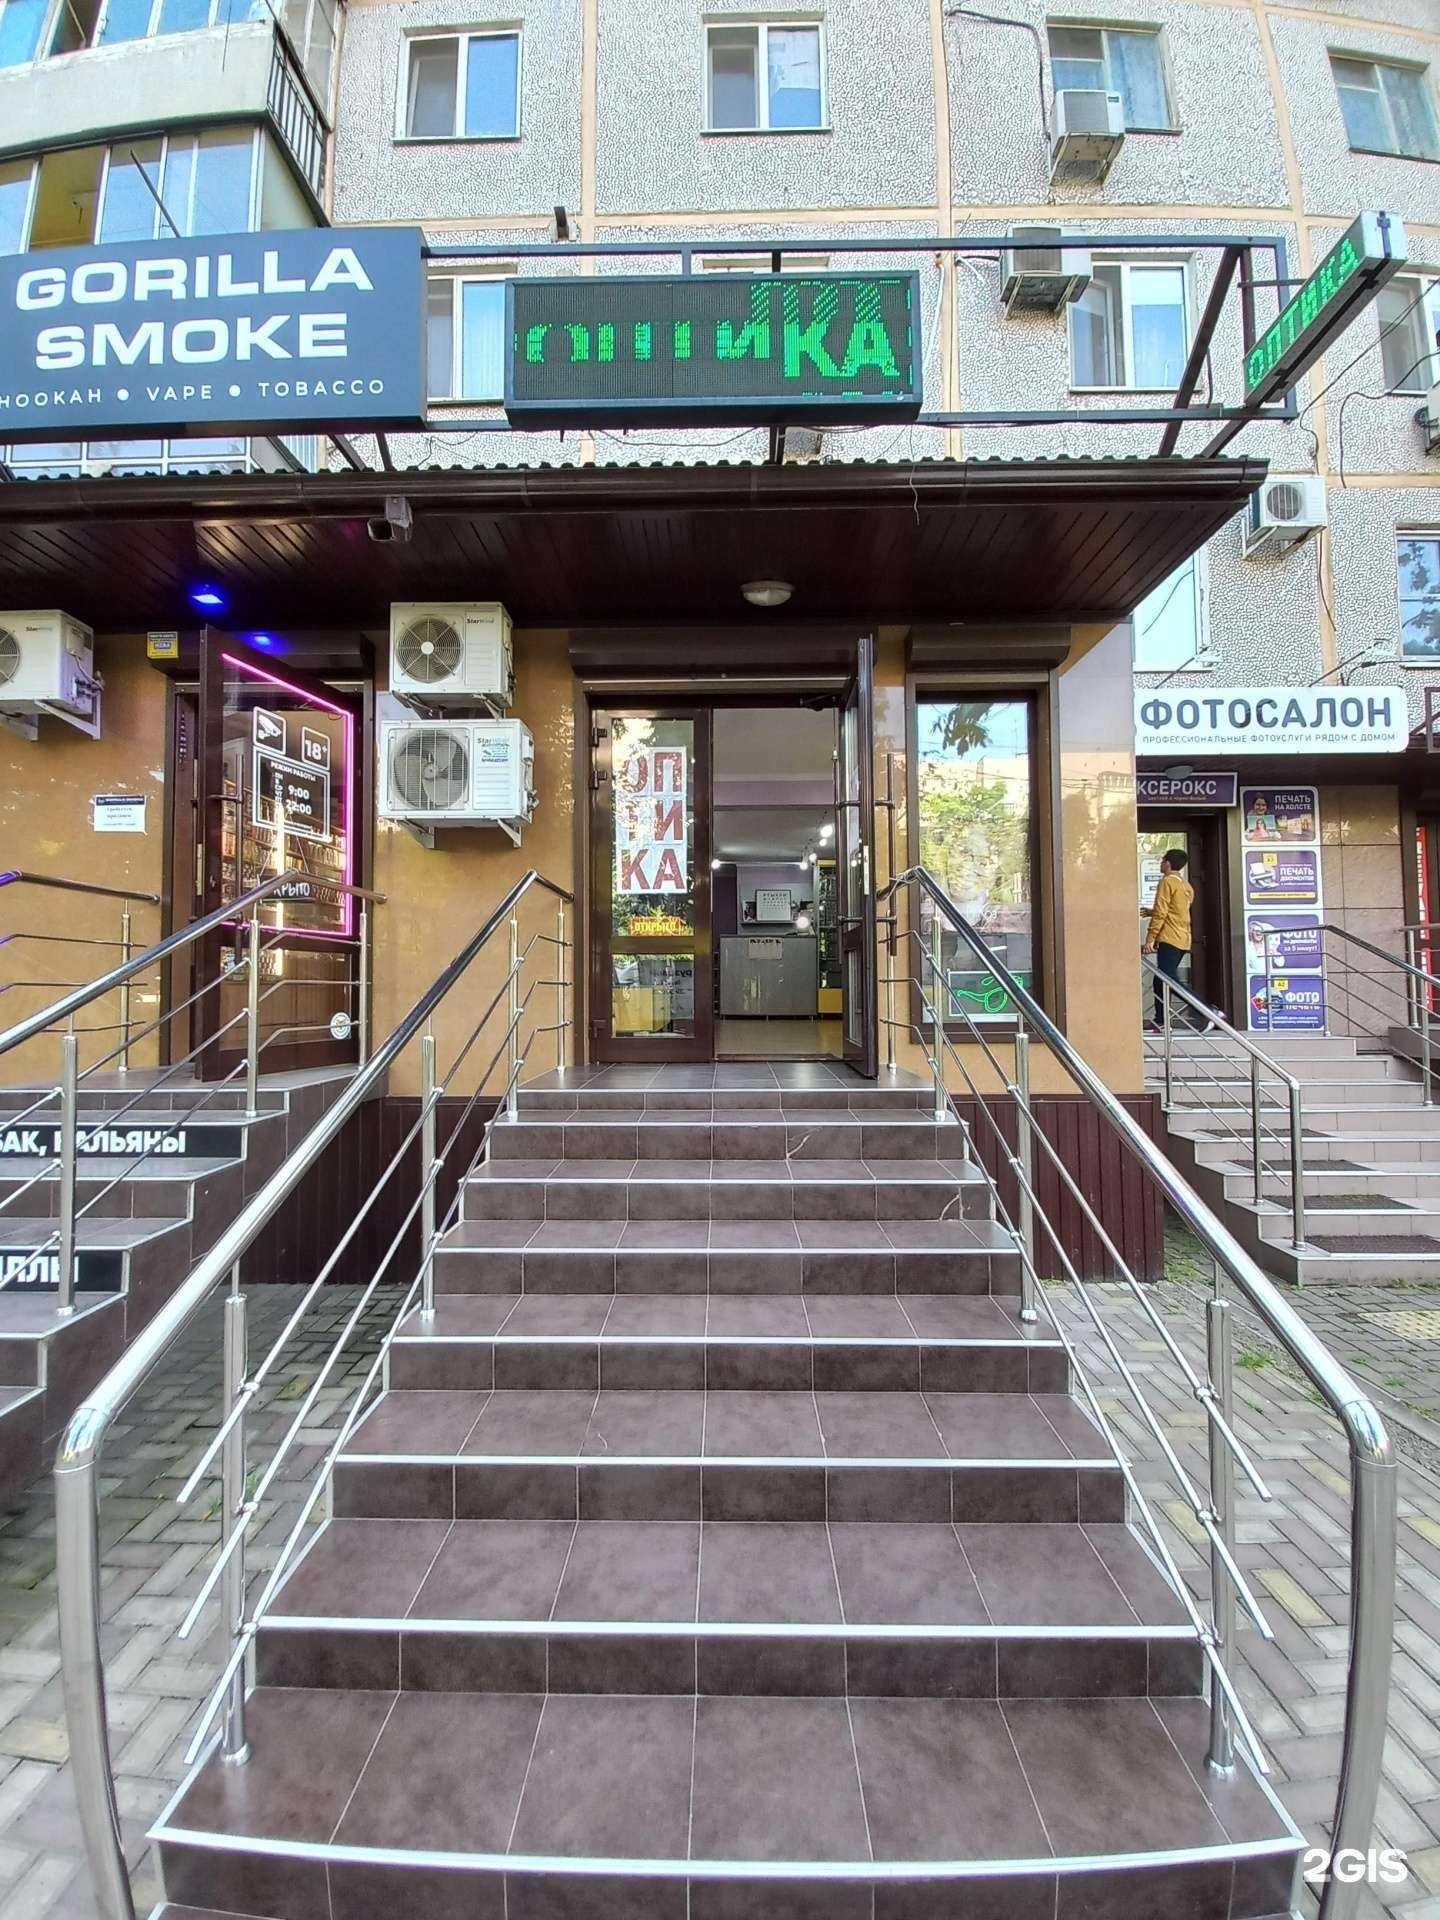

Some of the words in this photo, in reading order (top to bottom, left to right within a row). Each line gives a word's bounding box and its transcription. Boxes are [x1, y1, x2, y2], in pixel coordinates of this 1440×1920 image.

[15, 247, 375, 311] GORILLA
[1247, 238, 1359, 388] ОПТИКА
[35, 312, 348, 370] SMOKE
[0, 388, 101, 409] HOOKAH
[146, 385, 212, 402] VAPE
[258, 379, 385, 397] TOBACCO
[1140, 697, 1391, 730] ФОТОСАЛОН
[1142, 735, 1248, 744] ПРОФЕССИОНАЛЬНЫЕ
[1250, 734, 1312, 742] ФОТОУСЛУГИ
[1315, 733, 1348, 742] РЯДОМ
[1360, 733, 1396, 742] ДОМОМ
[304, 739, 328, 760] 18+
[287, 784, 310, 800] 9:00
[1137, 780, 1217, 795] КСЕРОКС
[286, 798, 312, 815] 22:00
[1275, 794, 1311, 804] ПЕЧАТЬ
[621, 849, 685, 889] КА
[1280, 867, 1314, 876] ПЕЧАТЬ
[1285, 991, 1320, 1003] ФОТО
[0, 1131, 47, 1156] АК,
